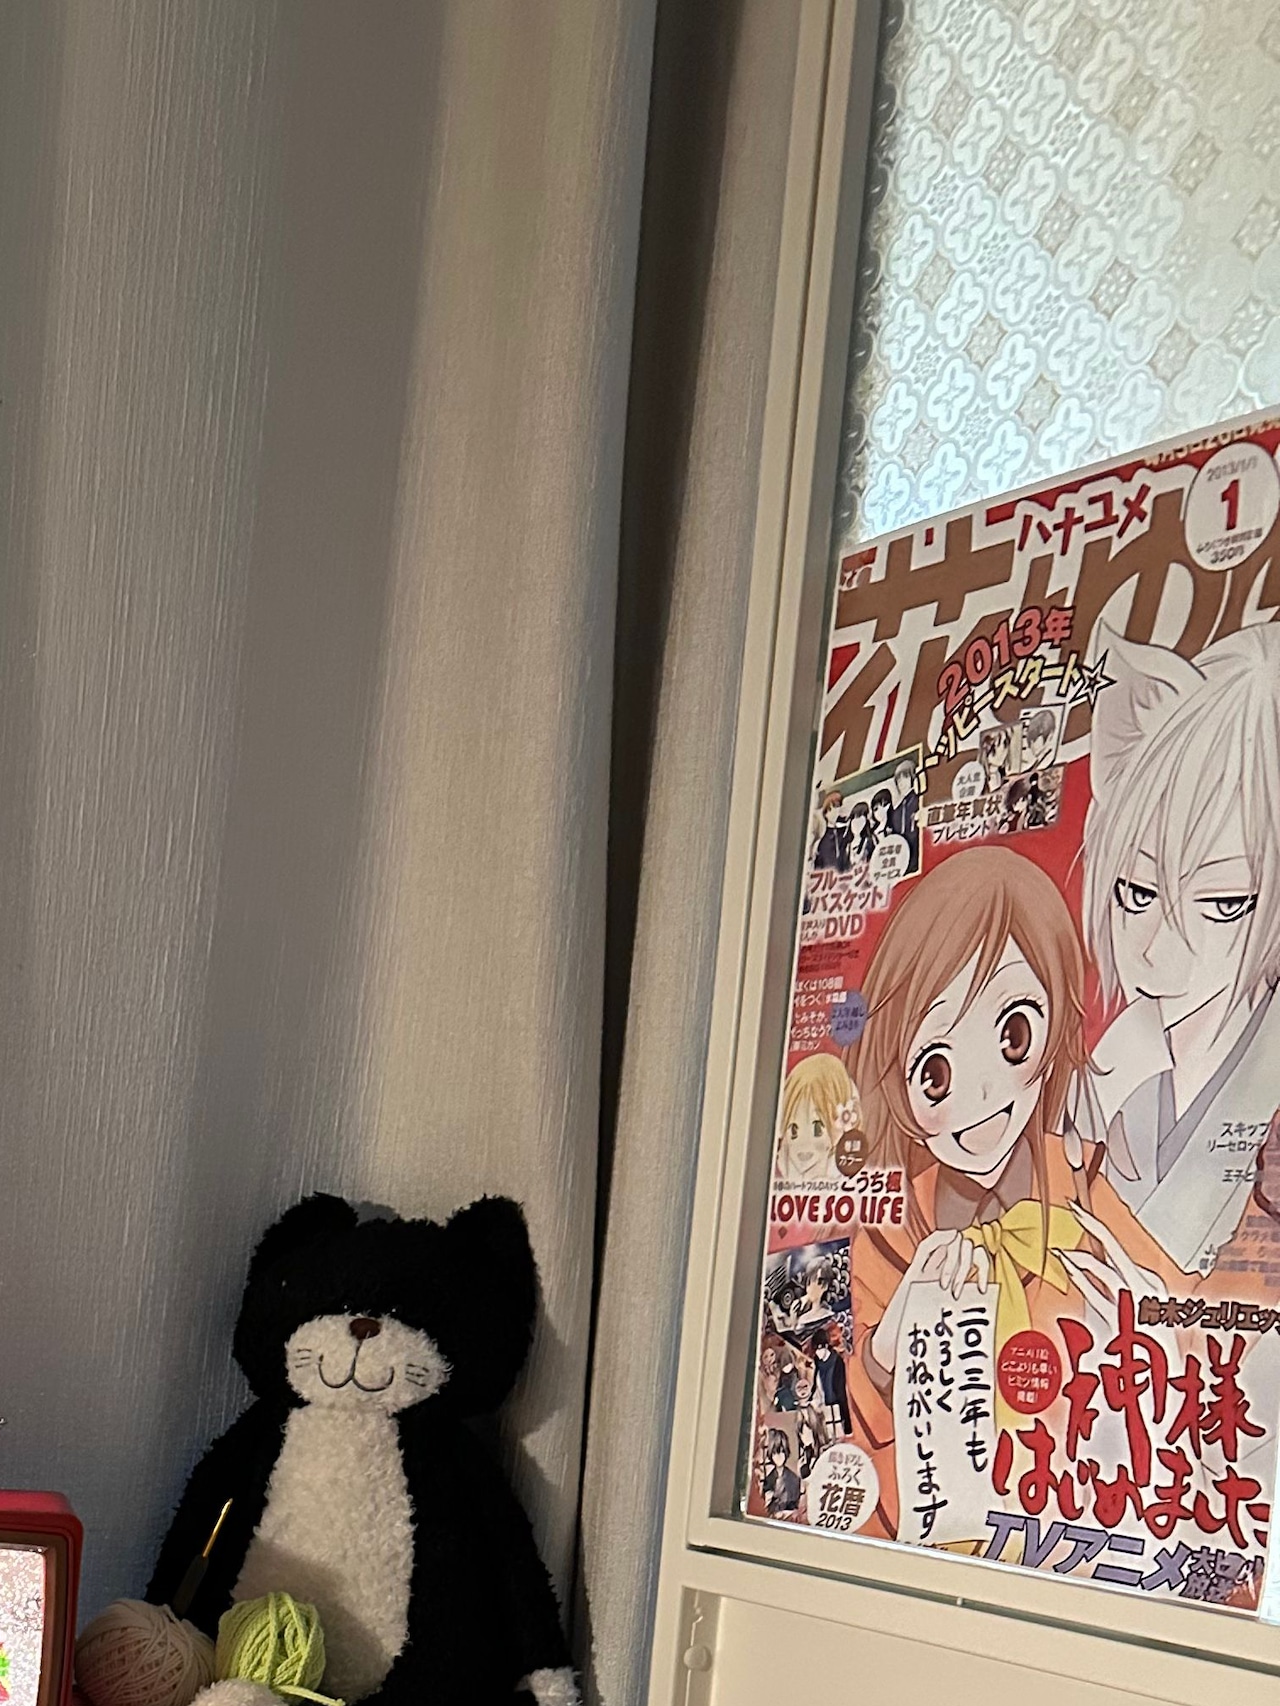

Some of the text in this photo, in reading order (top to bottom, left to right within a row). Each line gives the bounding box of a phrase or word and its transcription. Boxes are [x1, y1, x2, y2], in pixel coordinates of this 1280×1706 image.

[1018, 483, 1151, 556] ハナユメ
[1221, 478, 1240, 531] 1
[936, 605, 1076, 716] 2013年
[824, 913, 864, 939] DVD
[770, 1194, 904, 1225] LOVE SO LIFE
[933, 1307, 955, 1413] よろしく
[1056, 1288, 1267, 1490] 神様
[905, 1322, 949, 1540] おねがいします
[819, 1482, 866, 1517] 花暦
[827, 1467, 862, 1486] ふろく
[991, 1416, 1272, 1550] はじめました
[815, 1513, 853, 1531] 2013
[982, 1509, 1193, 1591] TVアニメ
